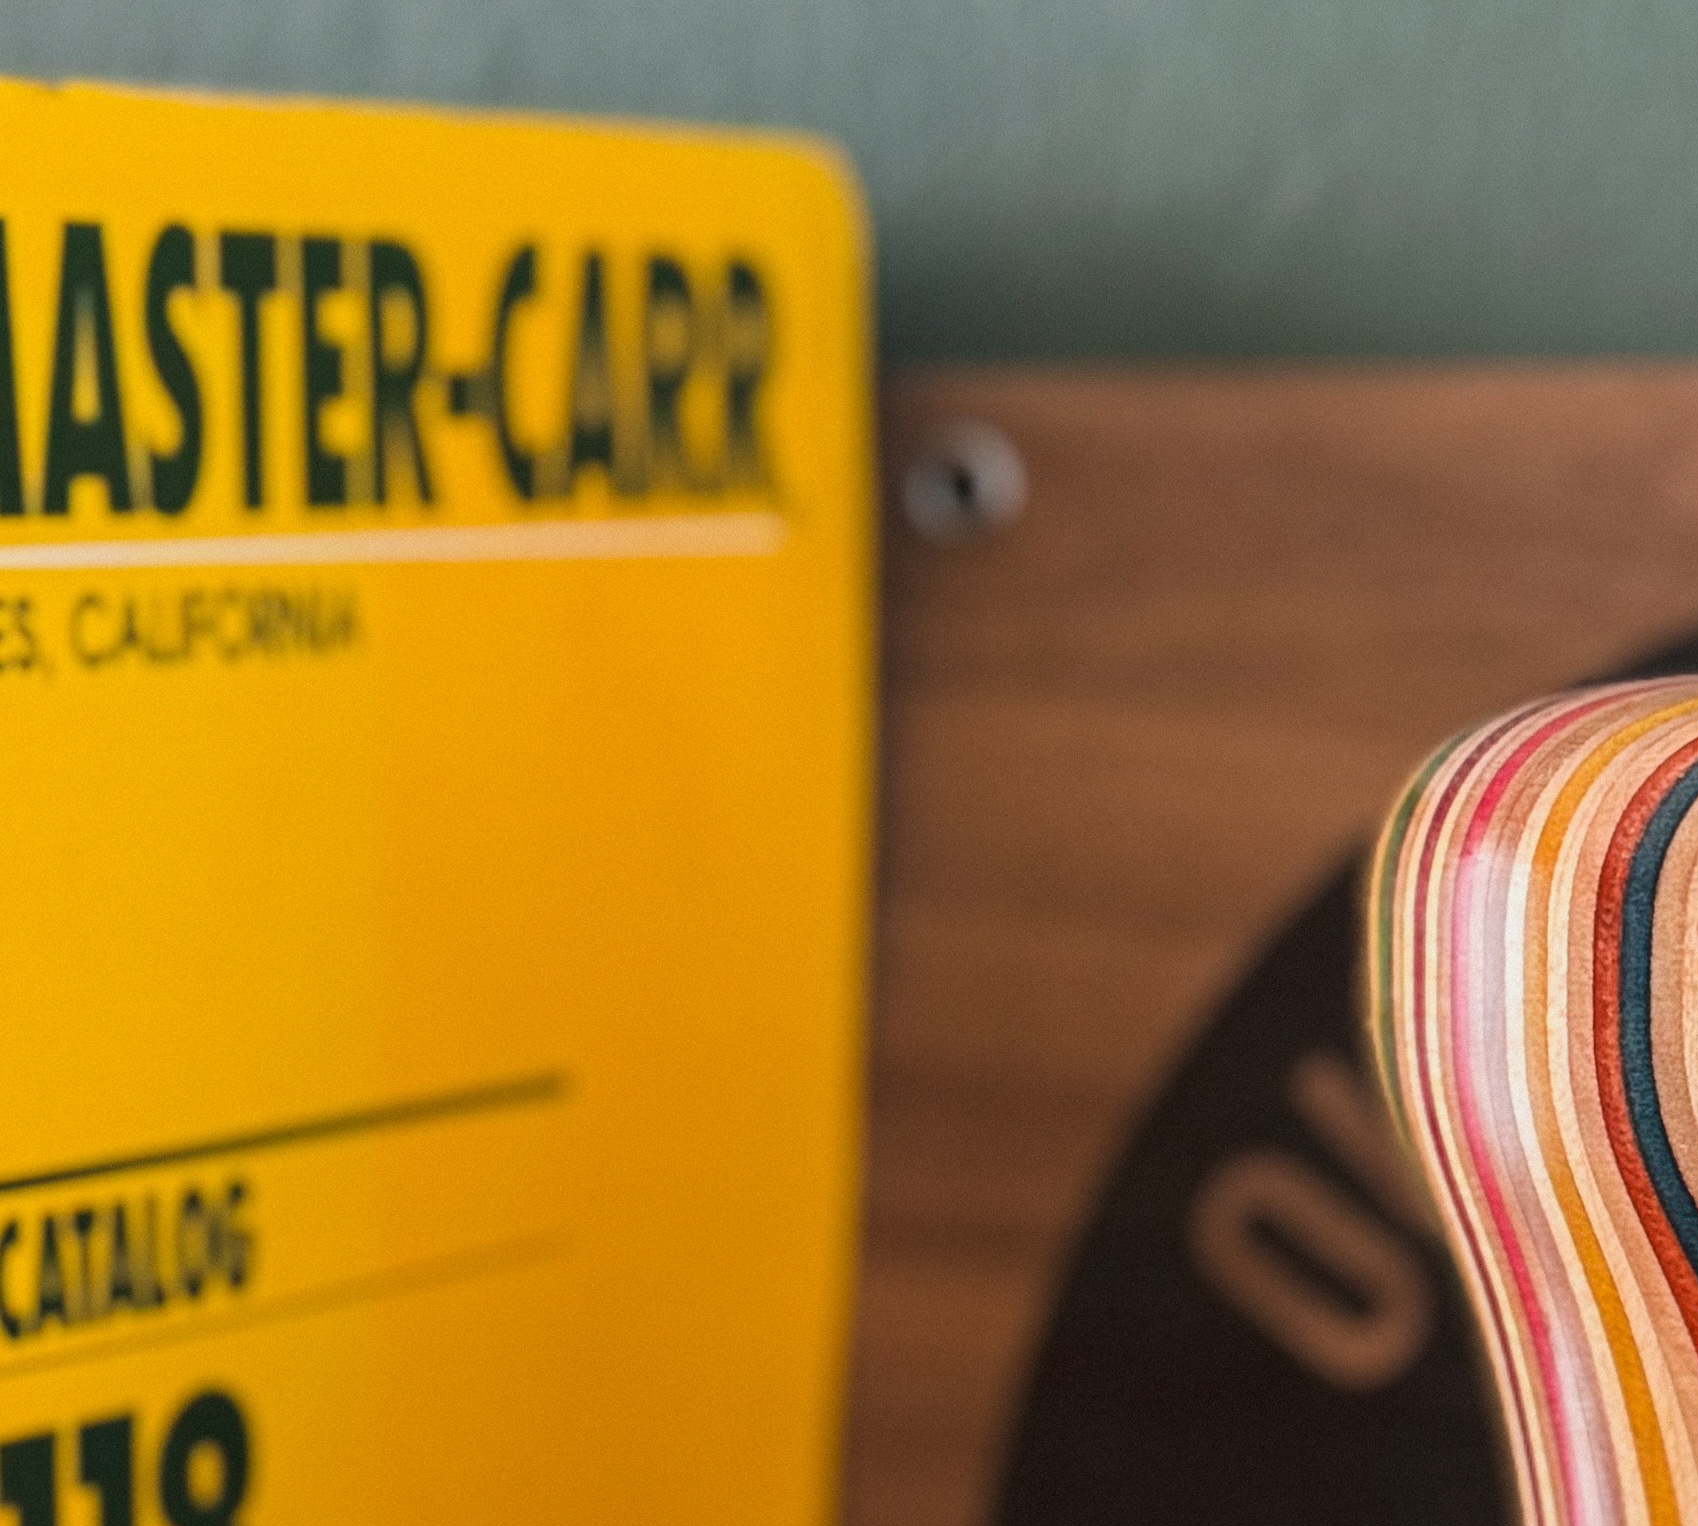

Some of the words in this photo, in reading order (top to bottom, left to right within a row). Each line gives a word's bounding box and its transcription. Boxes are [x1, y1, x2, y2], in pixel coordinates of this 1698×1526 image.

[0, 218, 778, 518] ASTER-CARR
[0, 596, 56, 680] S,
[68, 590, 358, 668] CALIFORNIA
[0, 1180, 252, 1338] CATALOG
